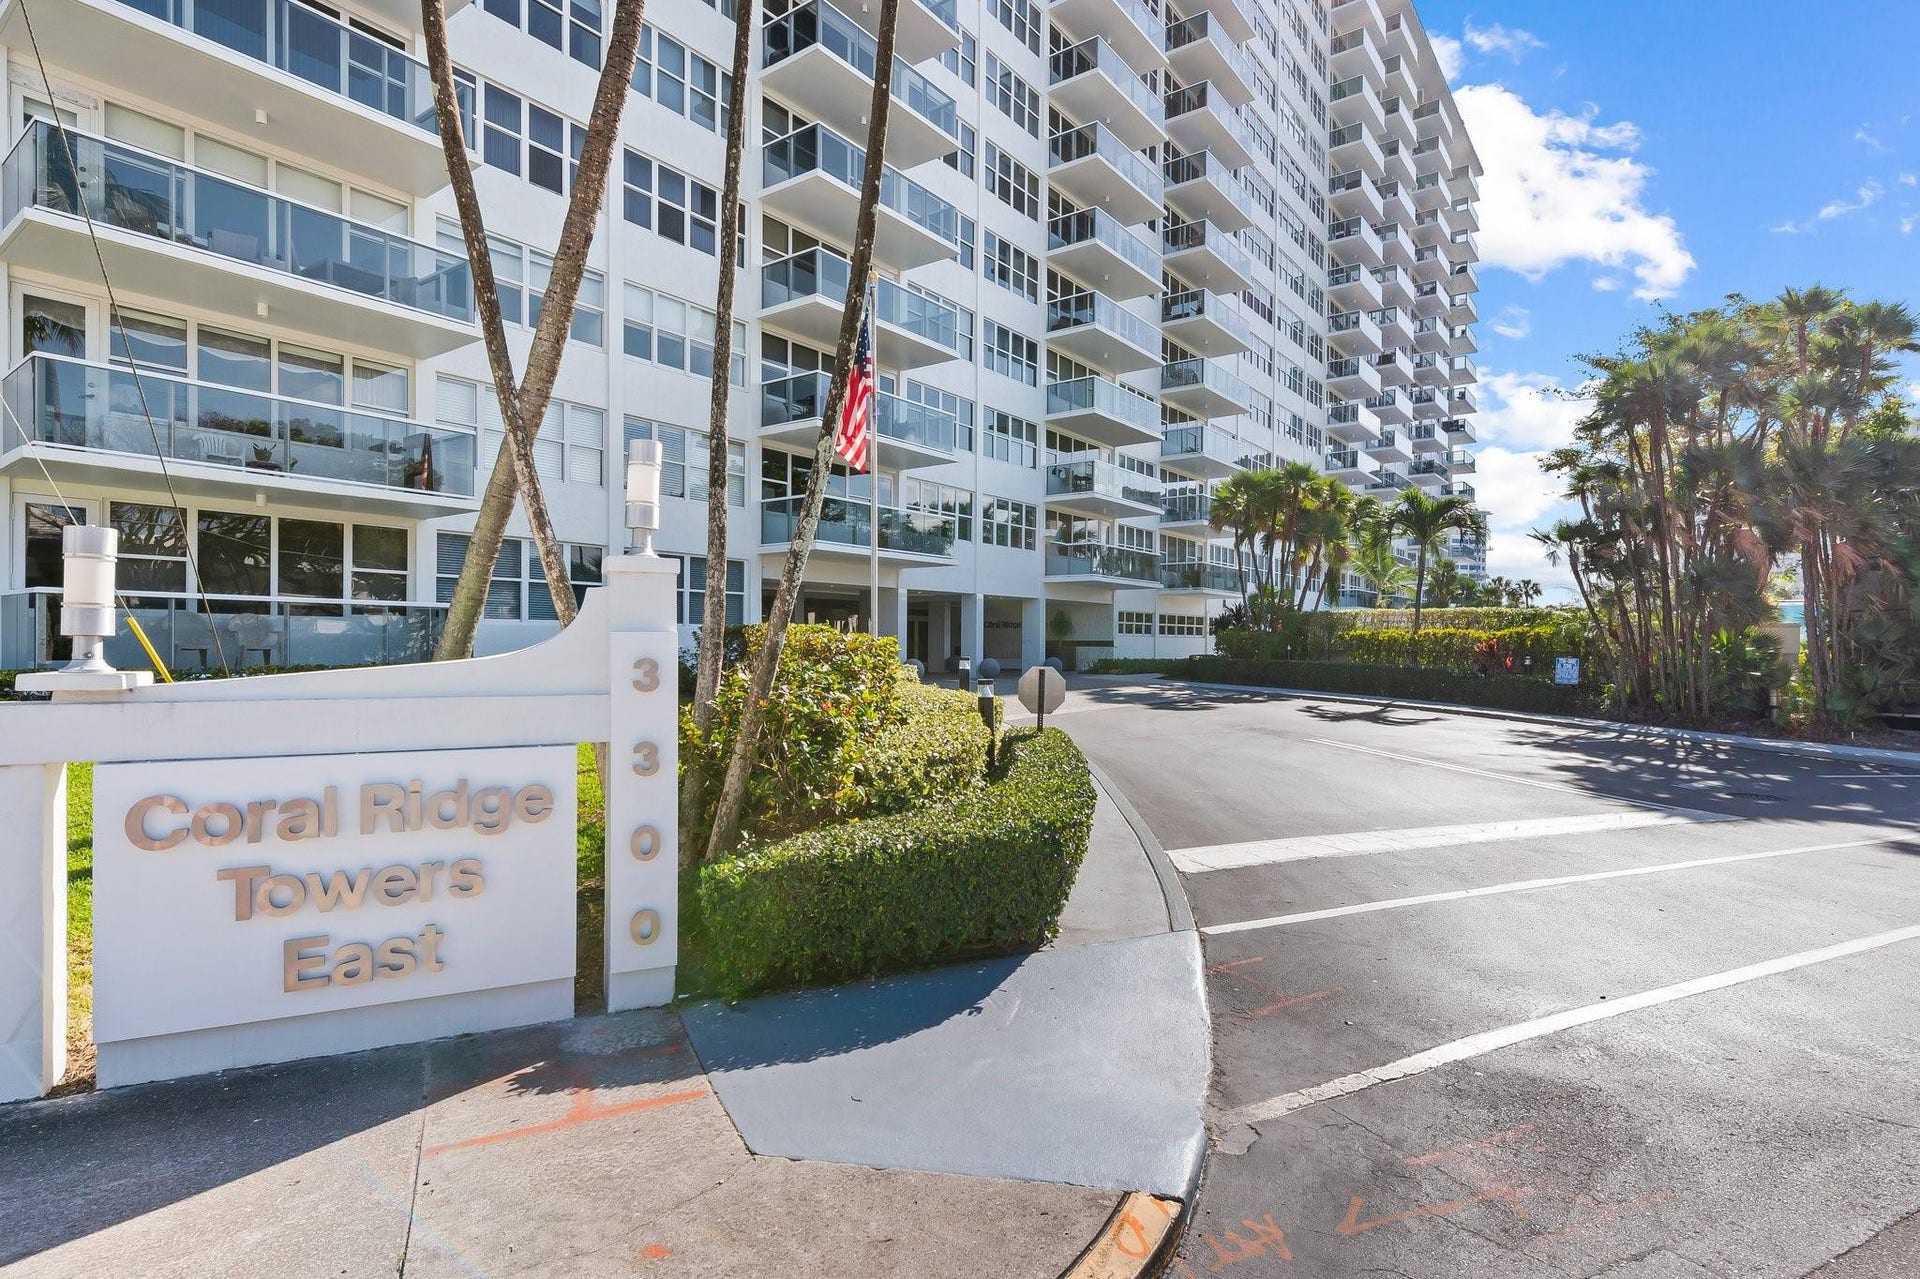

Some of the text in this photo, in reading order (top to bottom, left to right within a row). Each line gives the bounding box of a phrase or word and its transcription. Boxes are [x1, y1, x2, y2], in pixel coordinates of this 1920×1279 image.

[124, 778, 554, 851] Coral Ridge
[216, 857, 485, 922] Towers
[283, 924, 446, 992] East
